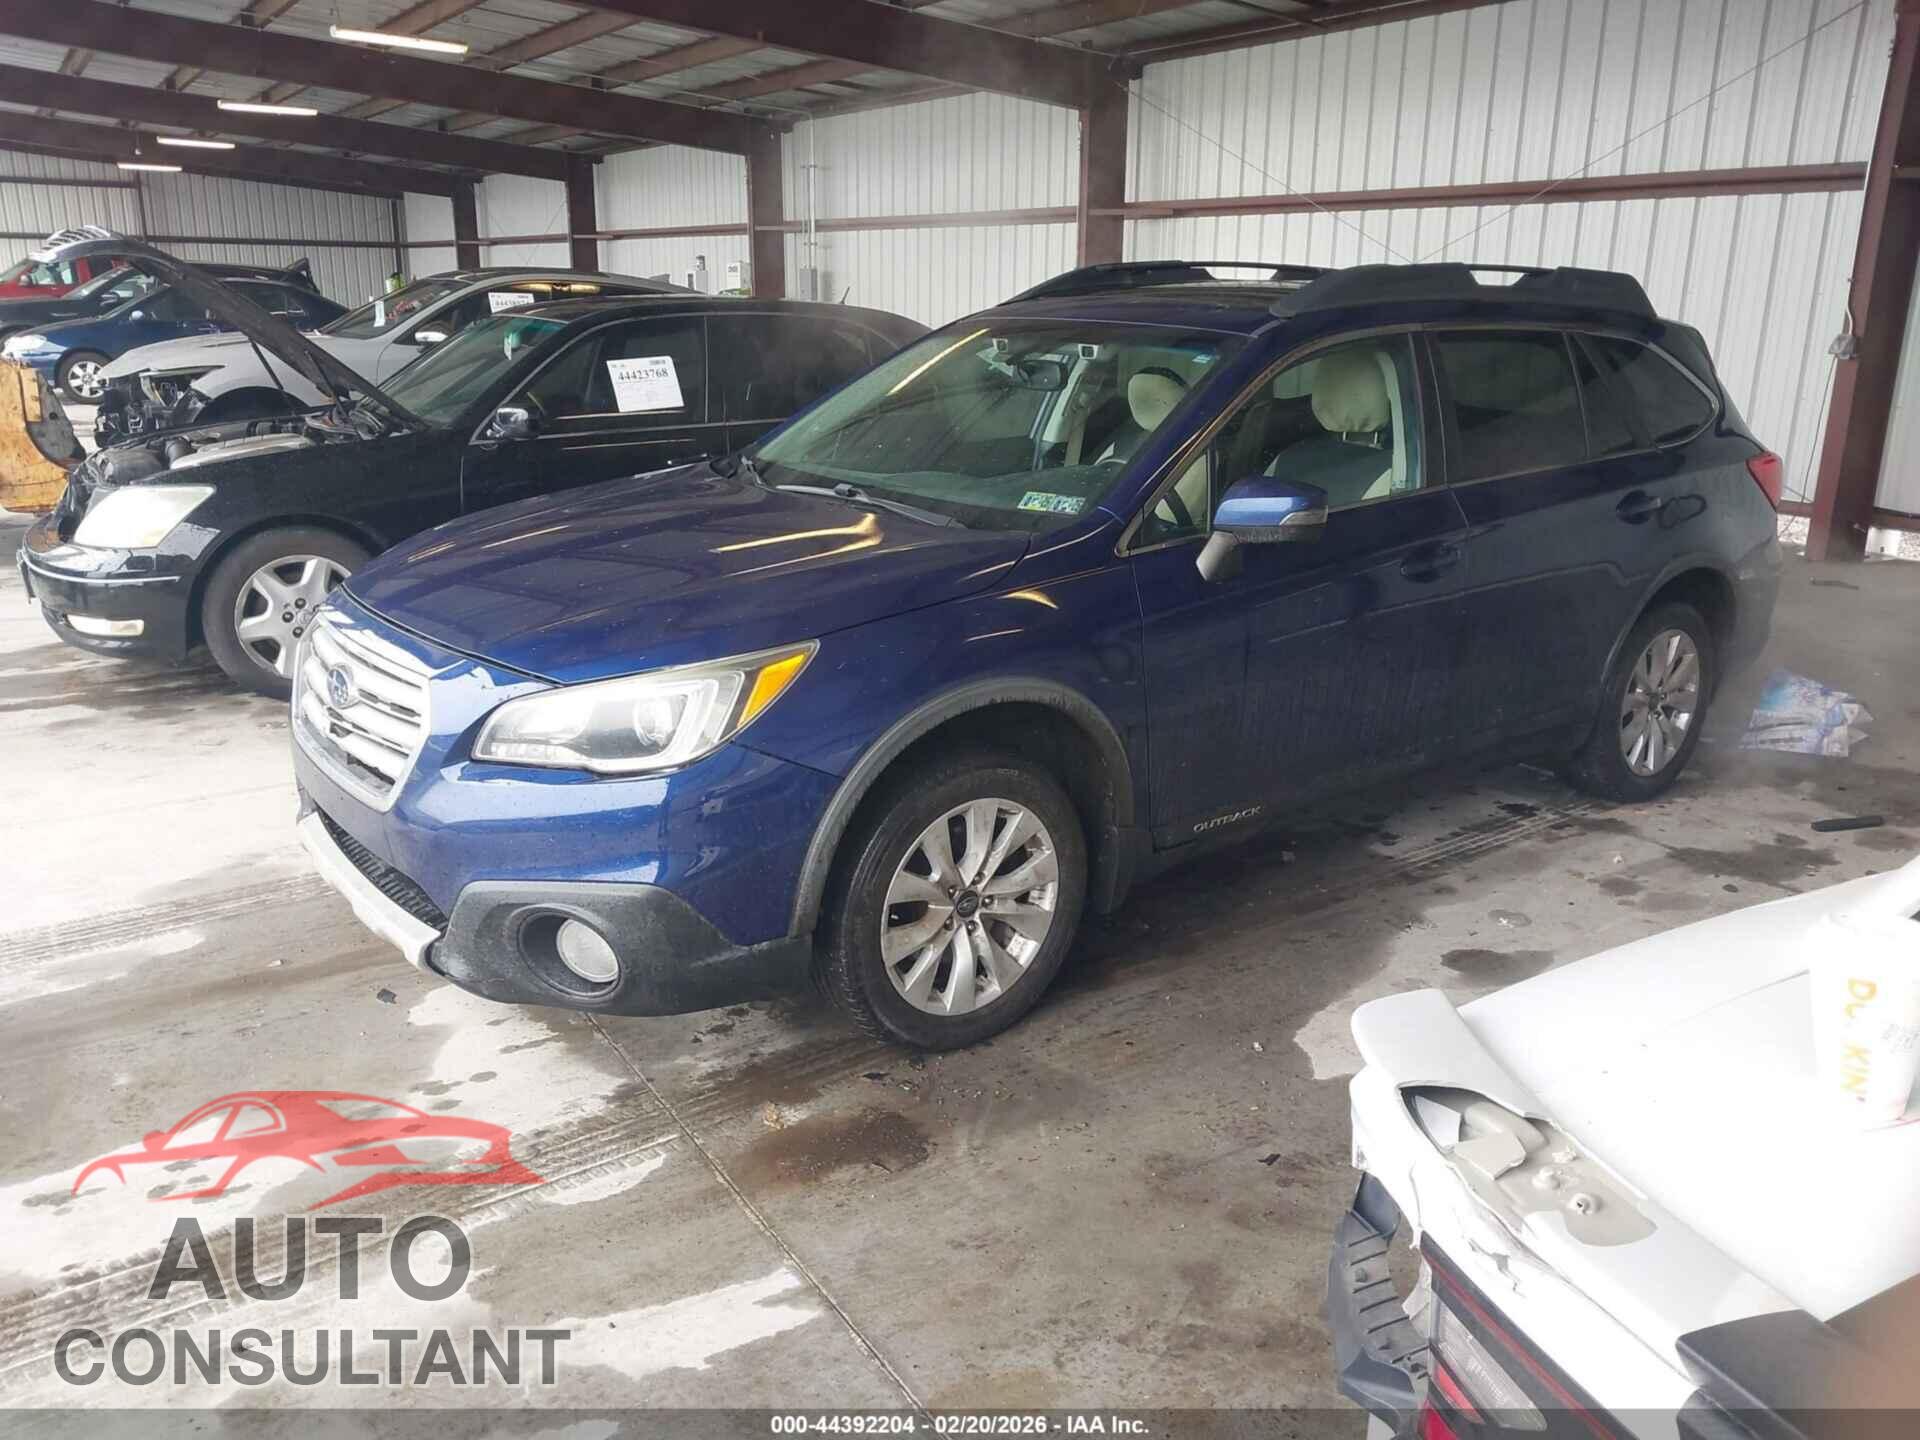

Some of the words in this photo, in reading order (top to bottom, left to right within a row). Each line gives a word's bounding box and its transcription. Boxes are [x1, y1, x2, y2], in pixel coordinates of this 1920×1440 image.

[617, 367, 669, 381] 44423768
[1193, 805, 1261, 833] OUTBACK
[1843, 977, 1878, 1103] DKIN'
